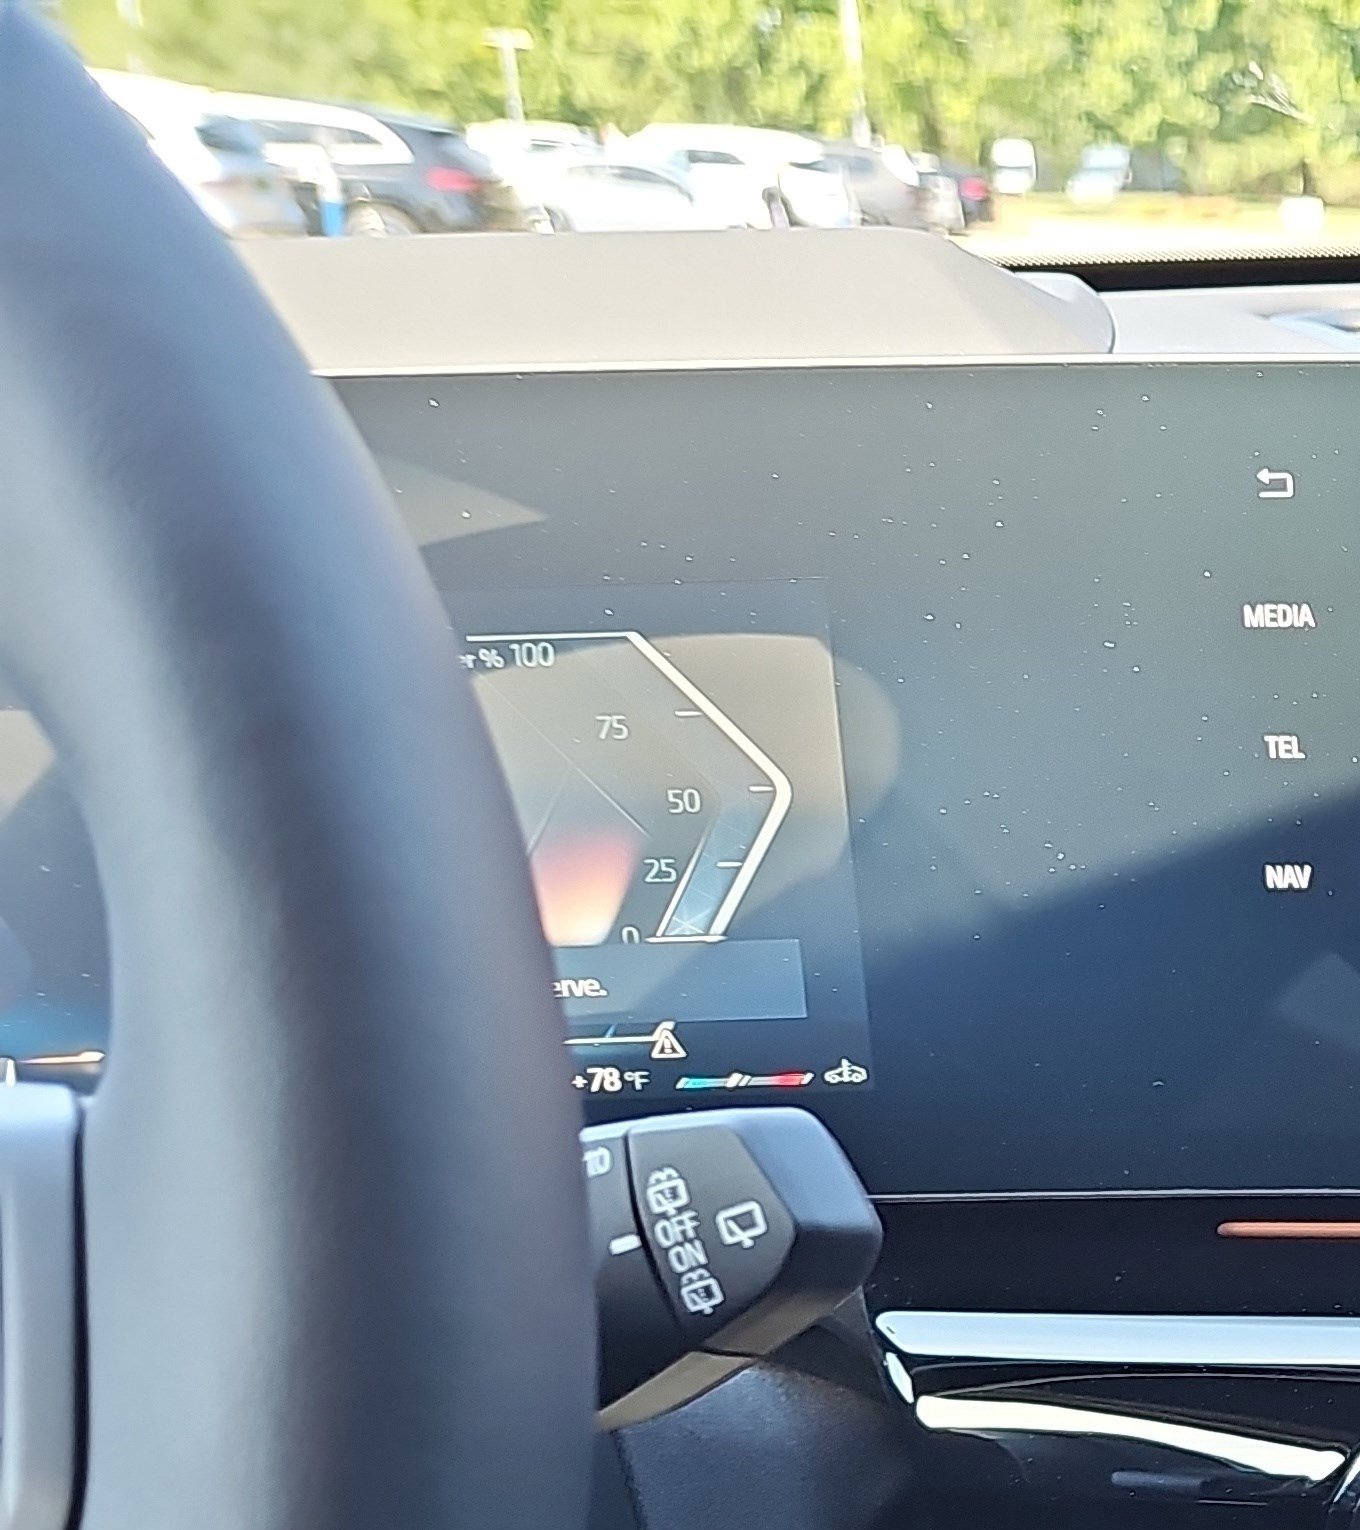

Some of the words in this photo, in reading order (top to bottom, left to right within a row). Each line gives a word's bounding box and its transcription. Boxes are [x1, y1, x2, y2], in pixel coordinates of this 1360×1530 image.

[1243, 603, 1315, 628] MEDIA
[508, 641, 556, 668] 100
[595, 715, 629, 740] 75
[1264, 735, 1306, 759] TEL
[667, 789, 700, 814] 50
[643, 859, 677, 883] 25
[1264, 864, 1312, 889] NAV
[654, 1210, 701, 1249] OFF
[668, 1239, 709, 1275] ON
